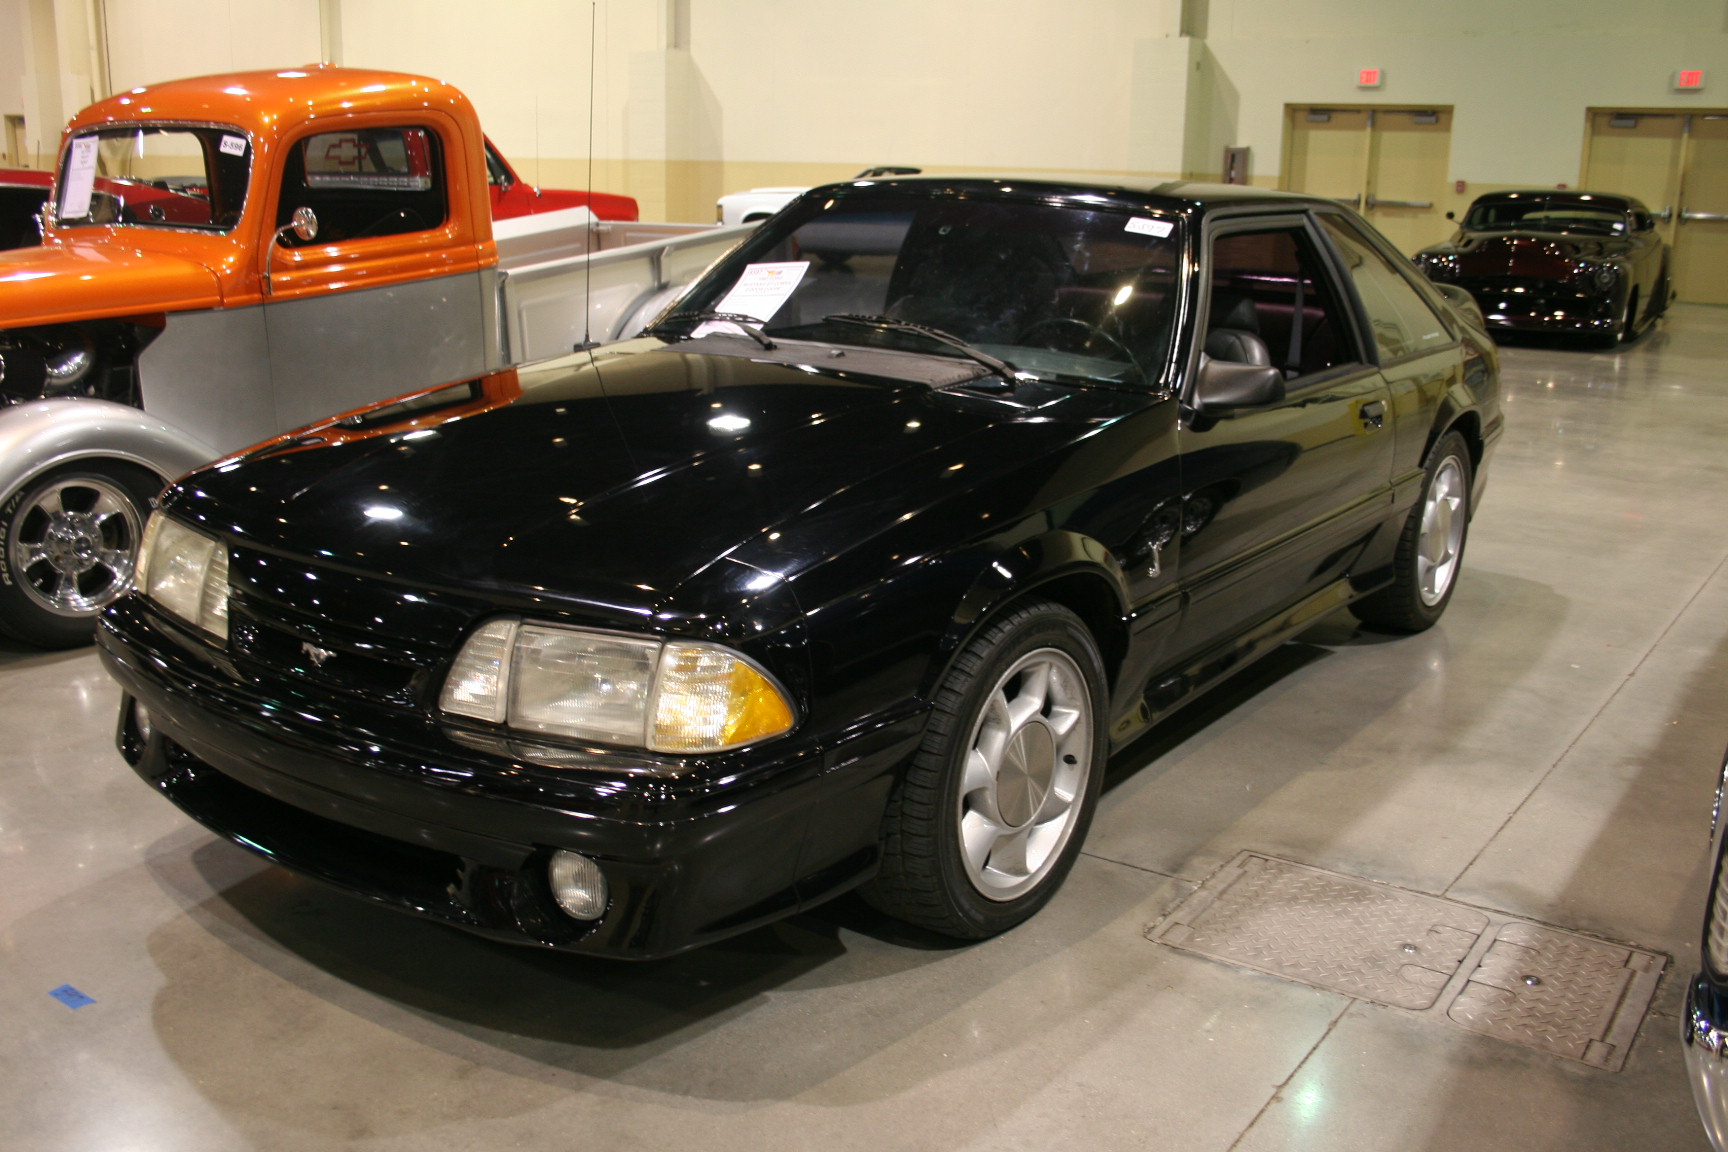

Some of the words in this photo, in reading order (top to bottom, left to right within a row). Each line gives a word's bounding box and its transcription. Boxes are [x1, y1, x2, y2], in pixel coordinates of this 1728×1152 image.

[1359, 69, 1380, 85] EXIT
[1679, 70, 1703, 87] EXIT
[222, 138, 243, 152] S-596
